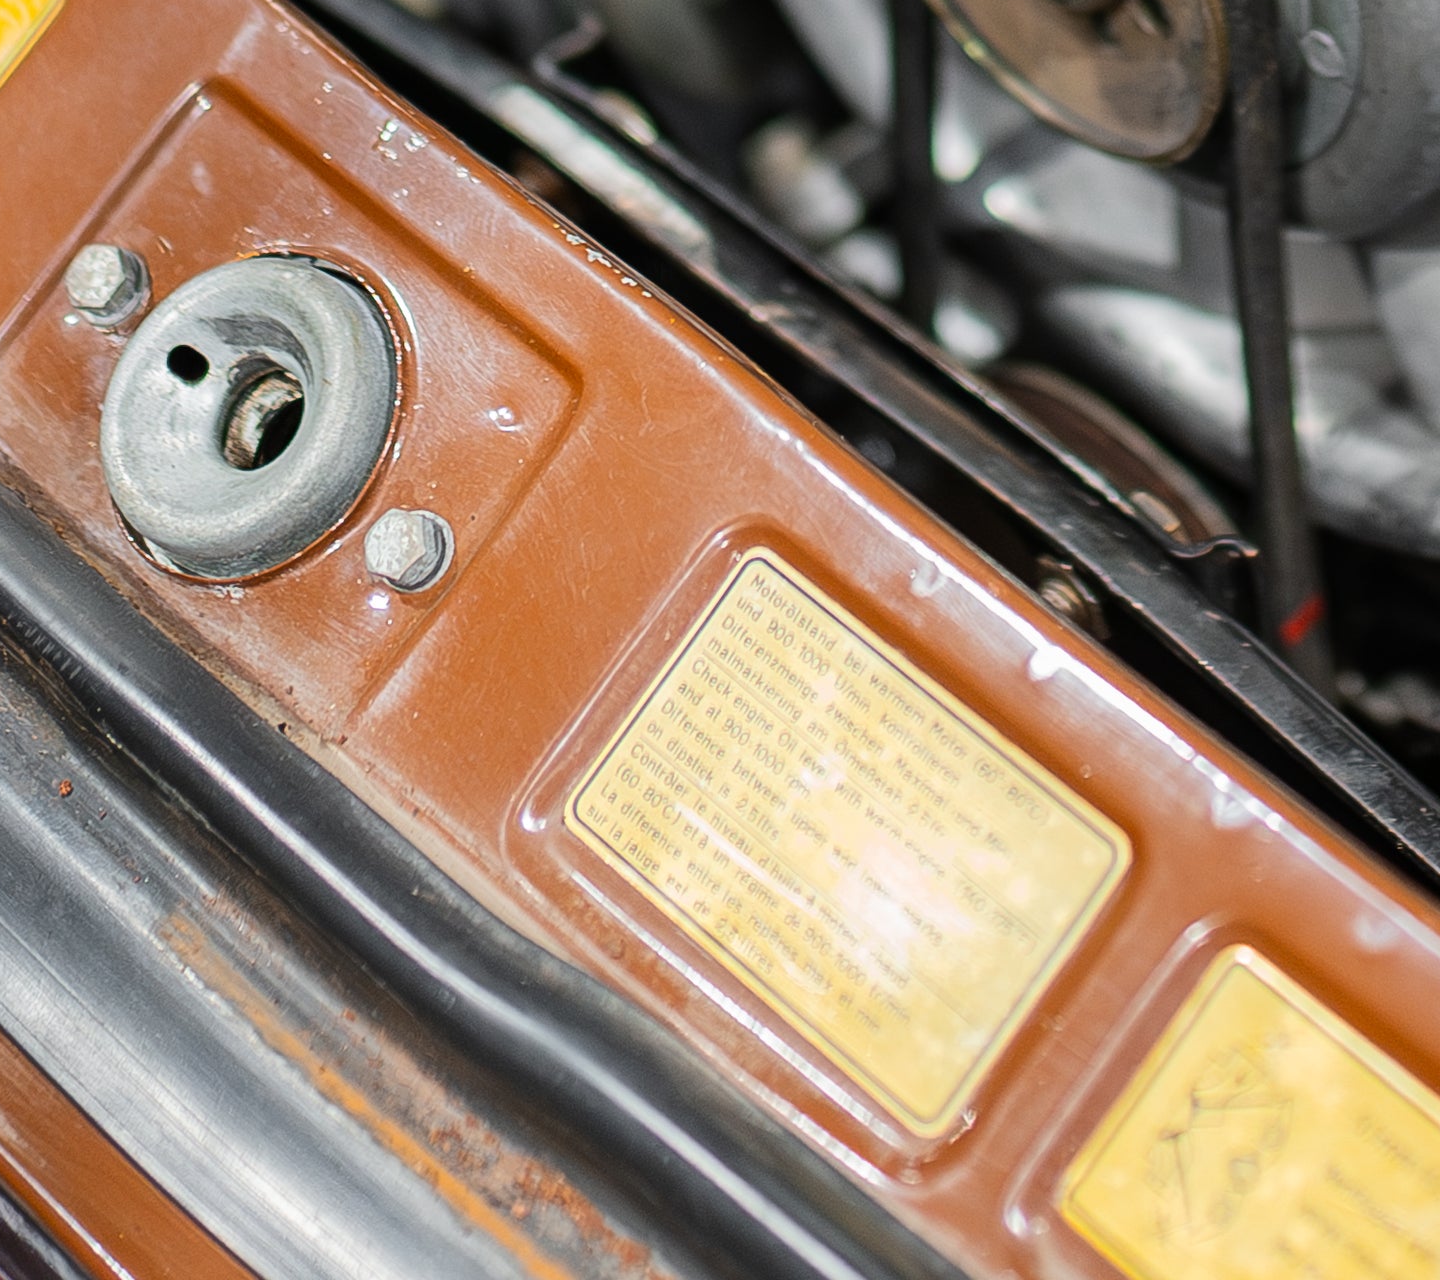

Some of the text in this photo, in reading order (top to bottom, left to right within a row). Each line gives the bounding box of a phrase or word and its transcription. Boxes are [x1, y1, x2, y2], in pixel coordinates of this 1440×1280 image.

[676, 678, 704, 707] and
[704, 701, 723, 722] at
[719, 714, 787, 777] 900-1000
[704, 635, 805, 724] malmarkierung
[805, 719, 830, 744] am
[716, 613, 822, 706] Differenzmenge
[822, 700, 887, 758] zwischen
[734, 595, 764, 624] und
[764, 617, 832, 678] 900-1000
[875, 712, 964, 789] kontrollieren
[746, 573, 839, 653] Motorölstand
[841, 650, 868, 677] bei
[865, 672, 928, 727] warmem
[926, 720, 972, 762] Motor
[644, 719, 665, 742] on
[662, 734, 717, 788] dipstick
[716, 780, 734, 801] is
[658, 697, 728, 762] Difference
[729, 758, 789, 814] between
[786, 810, 829, 852] upper
[688, 655, 736, 701] Check
[728, 693, 775, 738] engine
[774, 728, 800, 755] Oil
[832, 778, 866, 812] with
[584, 803, 609, 828] sur
[606, 820, 626, 842] la
[620, 836, 662, 879] jauge
[662, 871, 689, 899] est
[689, 896, 712, 921] de
[627, 741, 691, 802] Contrôler
[691, 795, 710, 817] le
[707, 811, 756, 858] niveau
[598, 781, 620, 805] La
[684, 857, 722, 896] entre
[720, 888, 745, 916] les
[835, 989, 857, 1013] et
[680, 819, 701, 842] et
[696, 832, 711, 851] à
[710, 847, 731, 870] un
[781, 908, 804, 933] de
